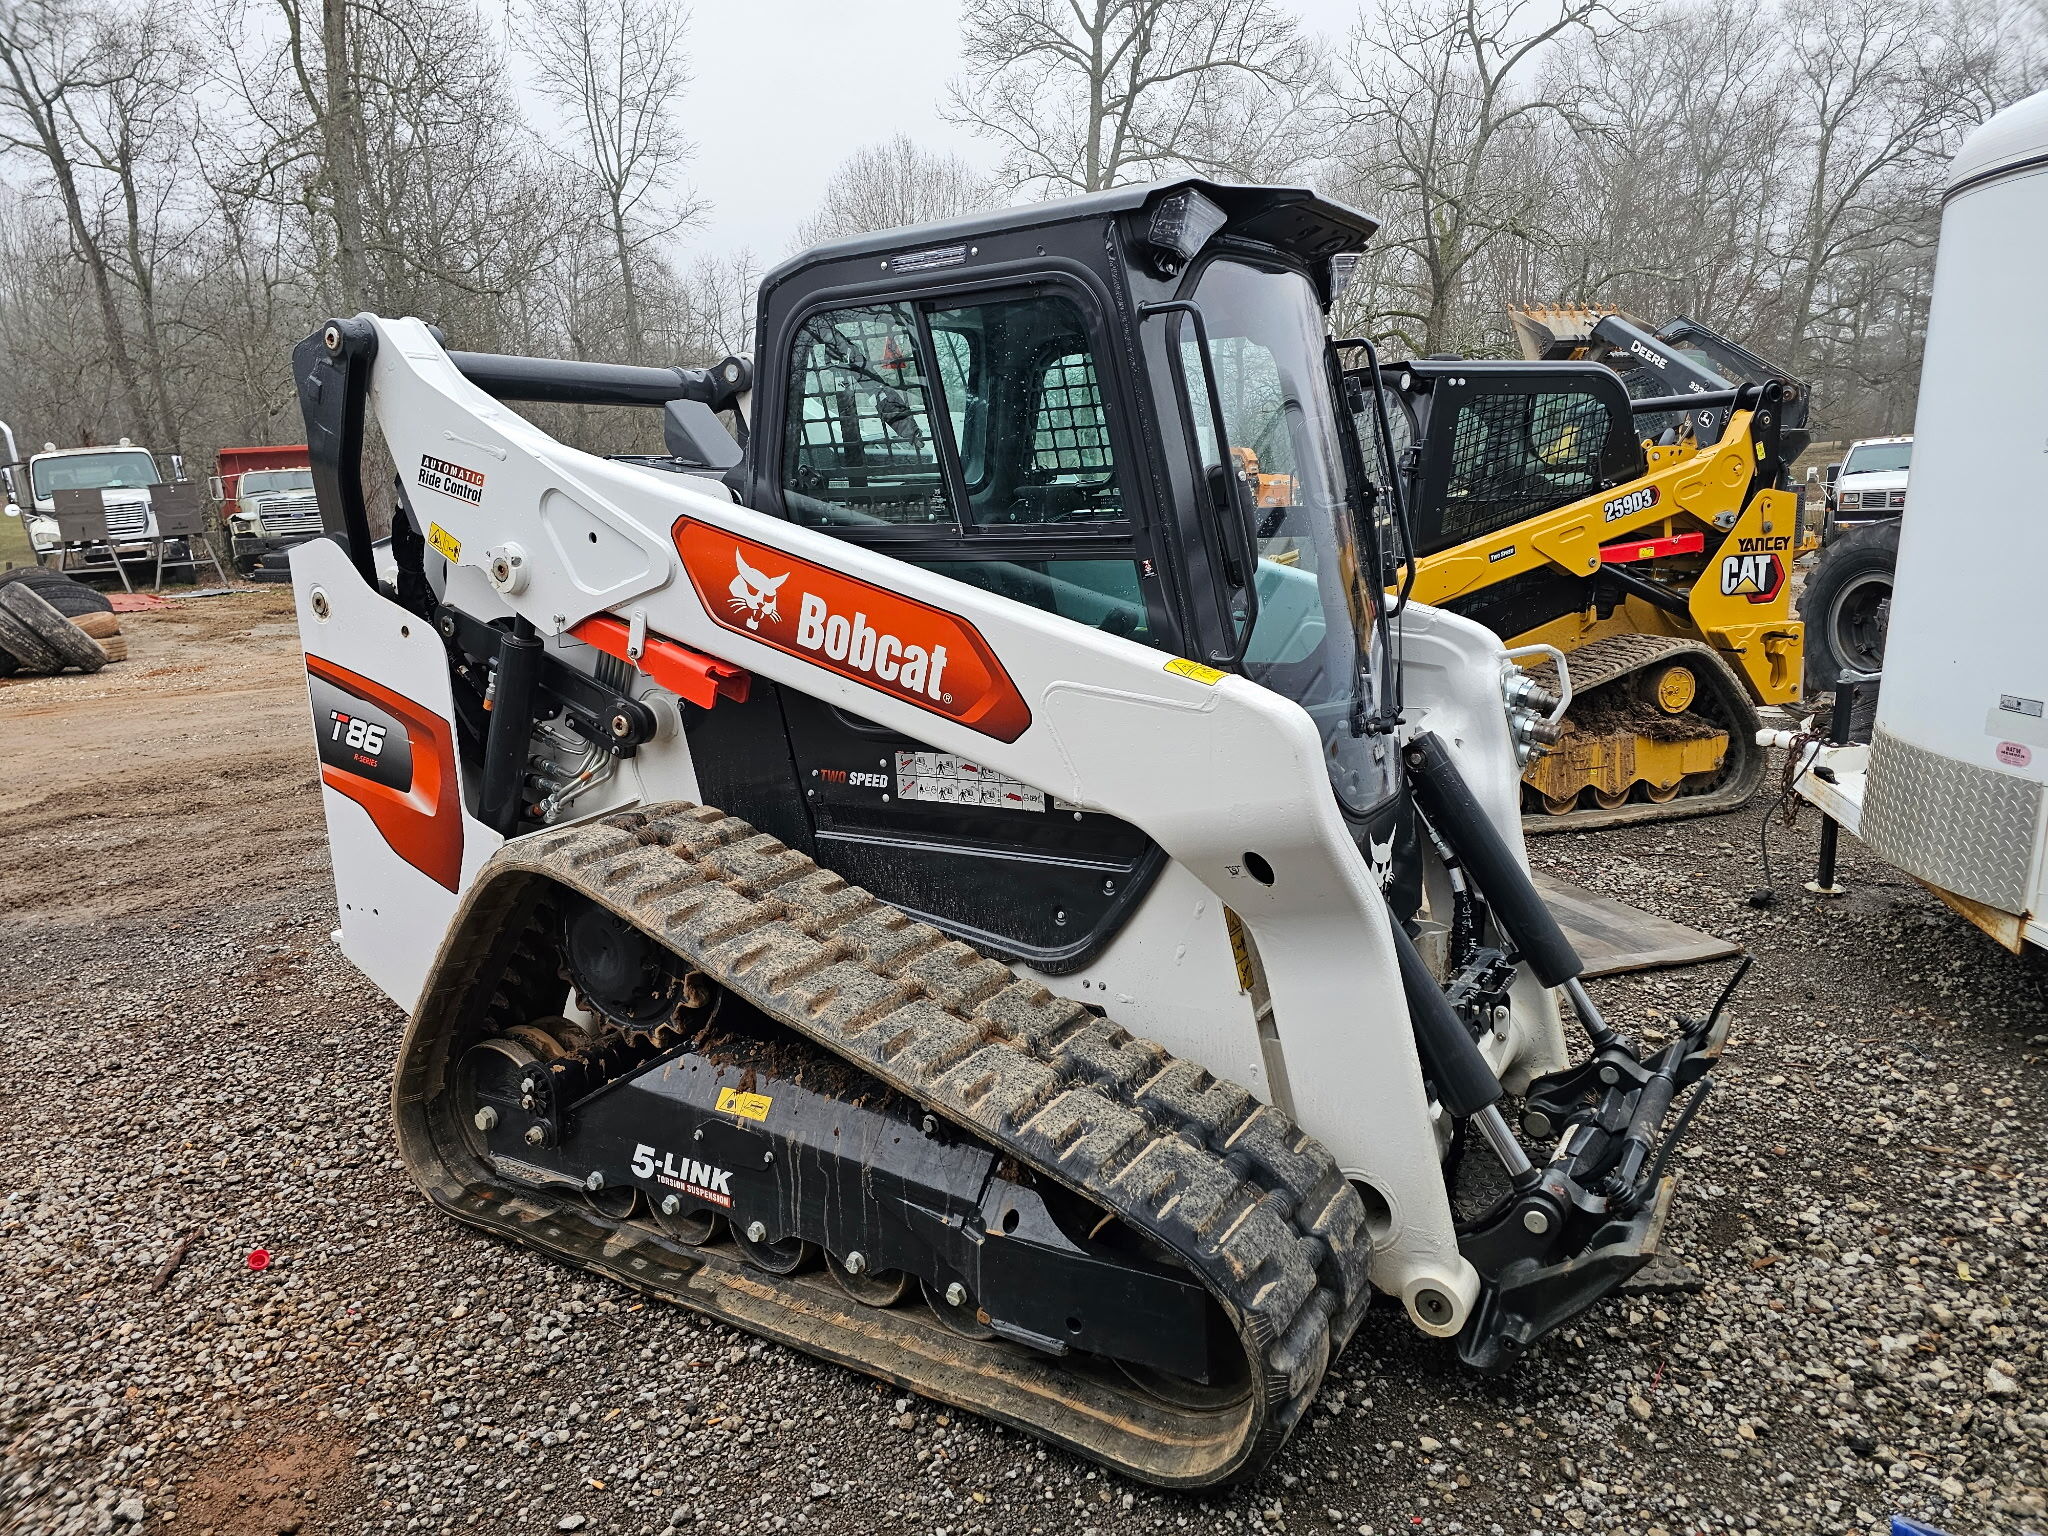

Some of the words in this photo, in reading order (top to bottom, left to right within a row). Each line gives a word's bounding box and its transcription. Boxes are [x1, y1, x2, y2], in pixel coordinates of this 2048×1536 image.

[1630, 340, 1668, 370] DEERE
[418, 468, 441, 489] Ride
[443, 478, 482, 503] Control
[423, 457, 482, 485] AUTOMATIC
[1604, 488, 1653, 522] 259D3
[1738, 536, 1791, 552] YANCEY
[1721, 554, 1771, 595] CAT
[796, 592, 948, 701] Bobcat
[330, 710, 387, 756] T86
[353, 753, 378, 768] R-SERIES
[820, 769, 847, 784] TWO
[848, 771, 889, 788] SPEED
[630, 1143, 733, 1195] 5-LINK
[656, 1174, 685, 1191] TORSION
[686, 1184, 730, 1206] SUSPENSION
